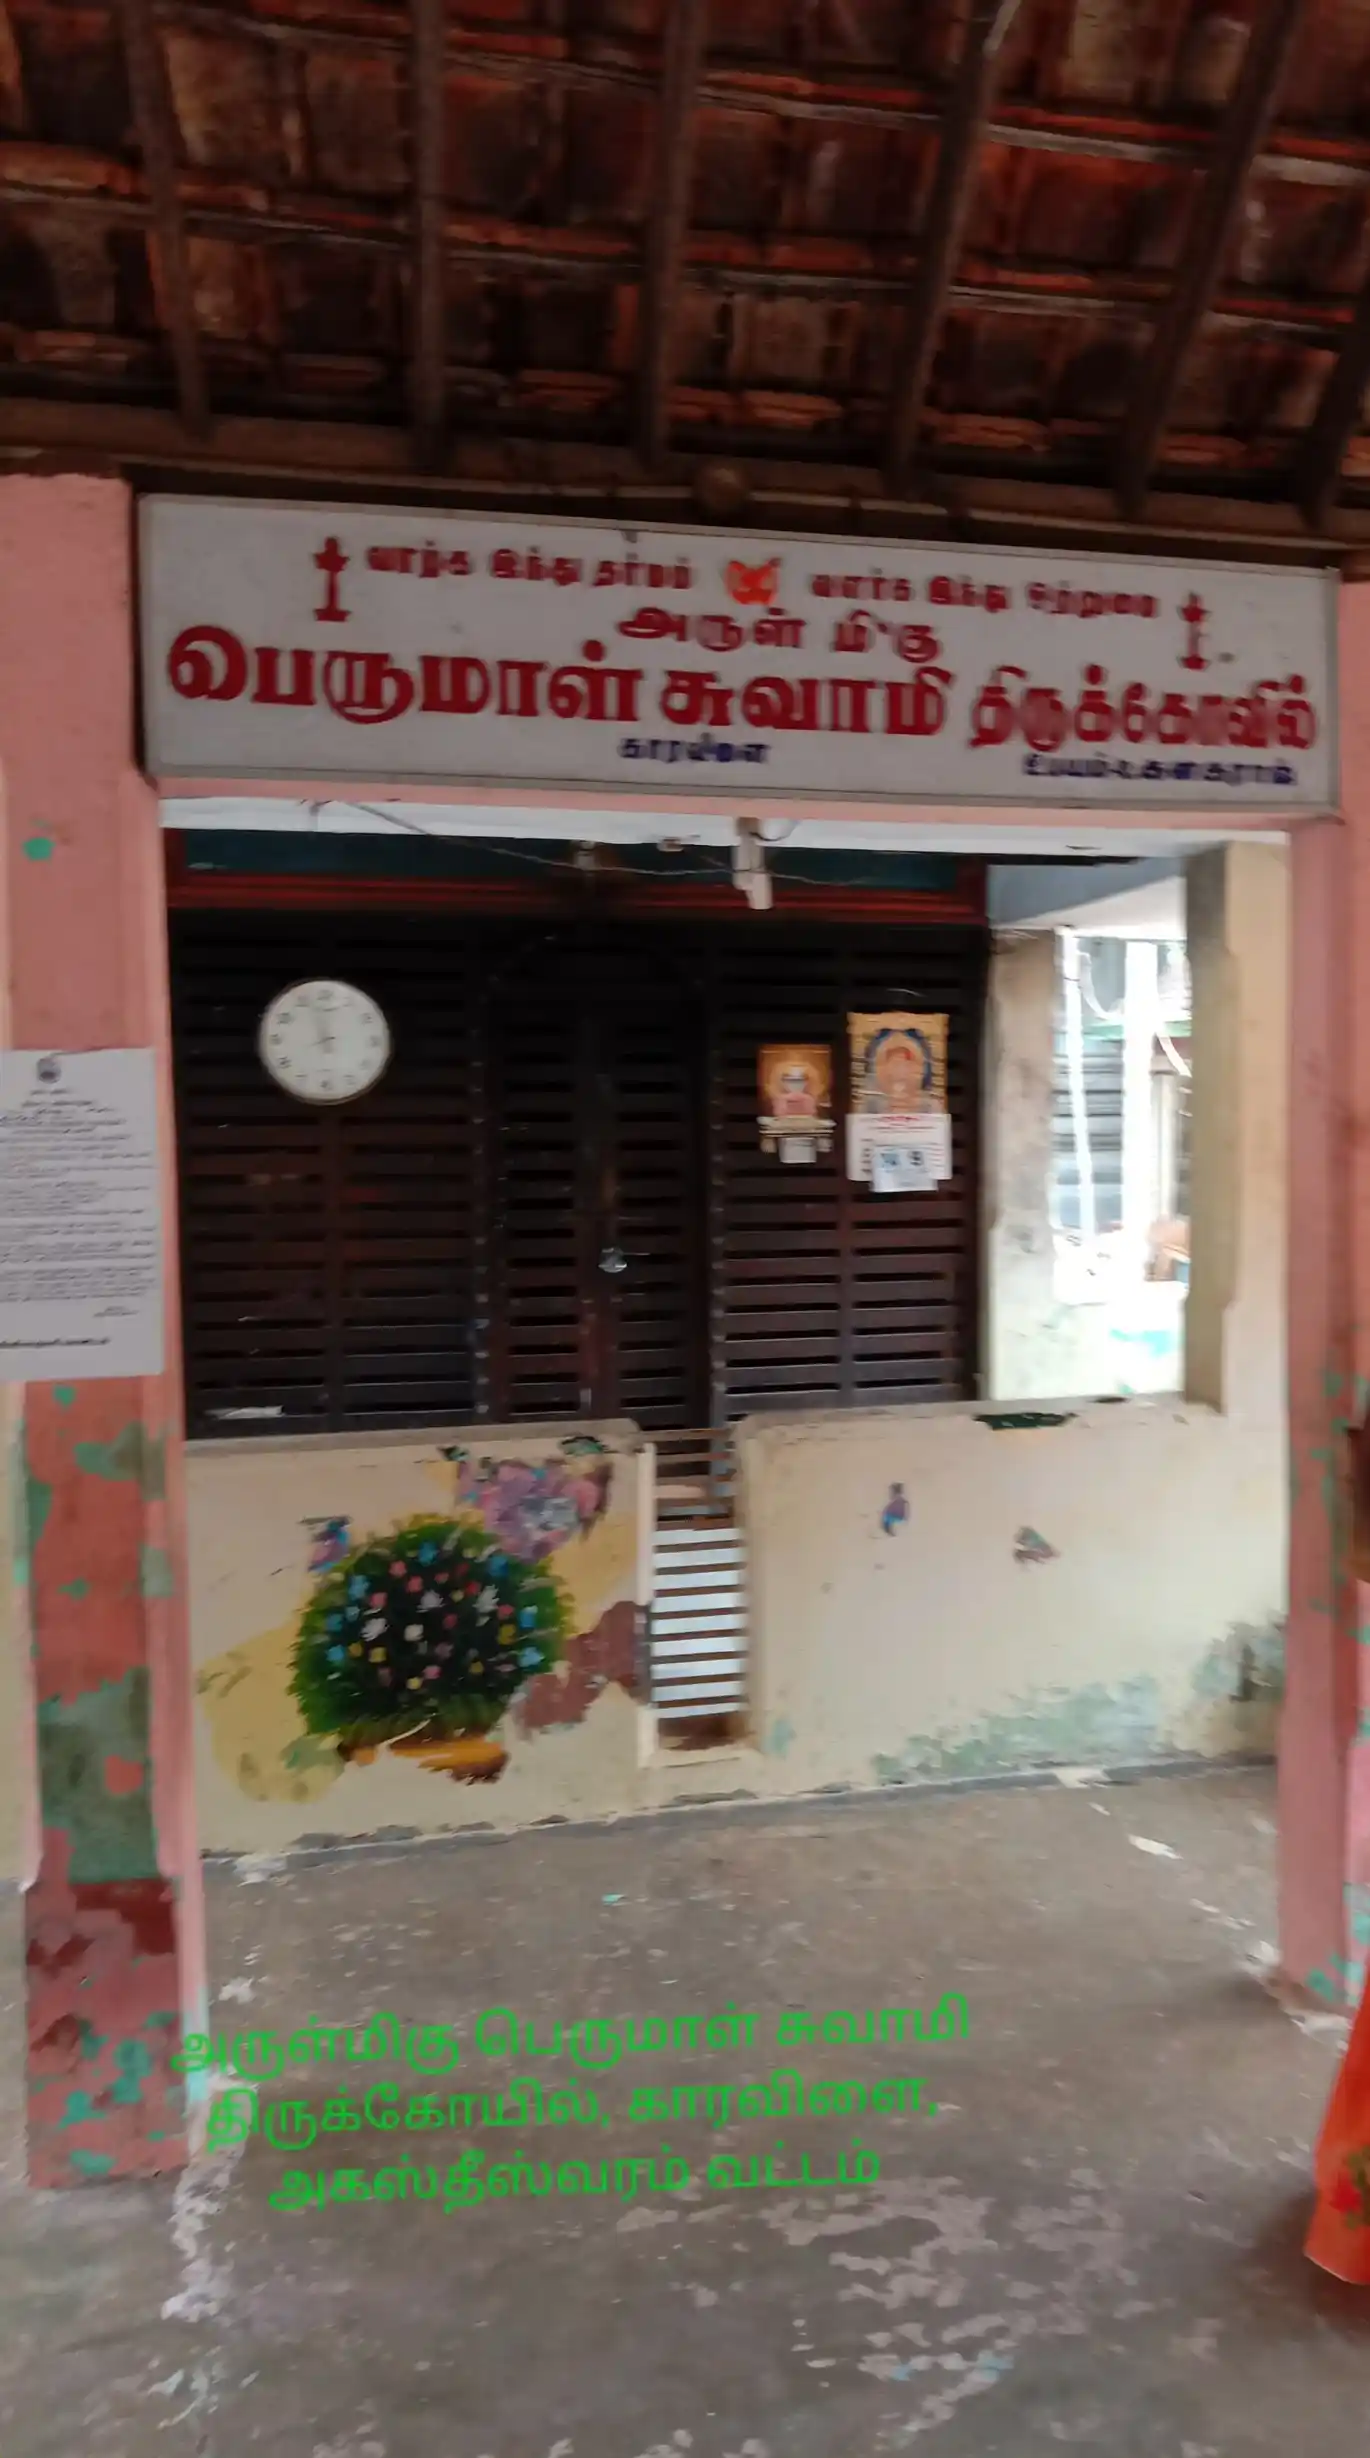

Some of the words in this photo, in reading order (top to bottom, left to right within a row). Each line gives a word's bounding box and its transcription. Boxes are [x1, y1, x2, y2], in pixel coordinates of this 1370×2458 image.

[619, 607, 804, 652] அருள்
[168, 625, 644, 724] பெருமாள்
[661, 666, 954, 736] சுவாமி
